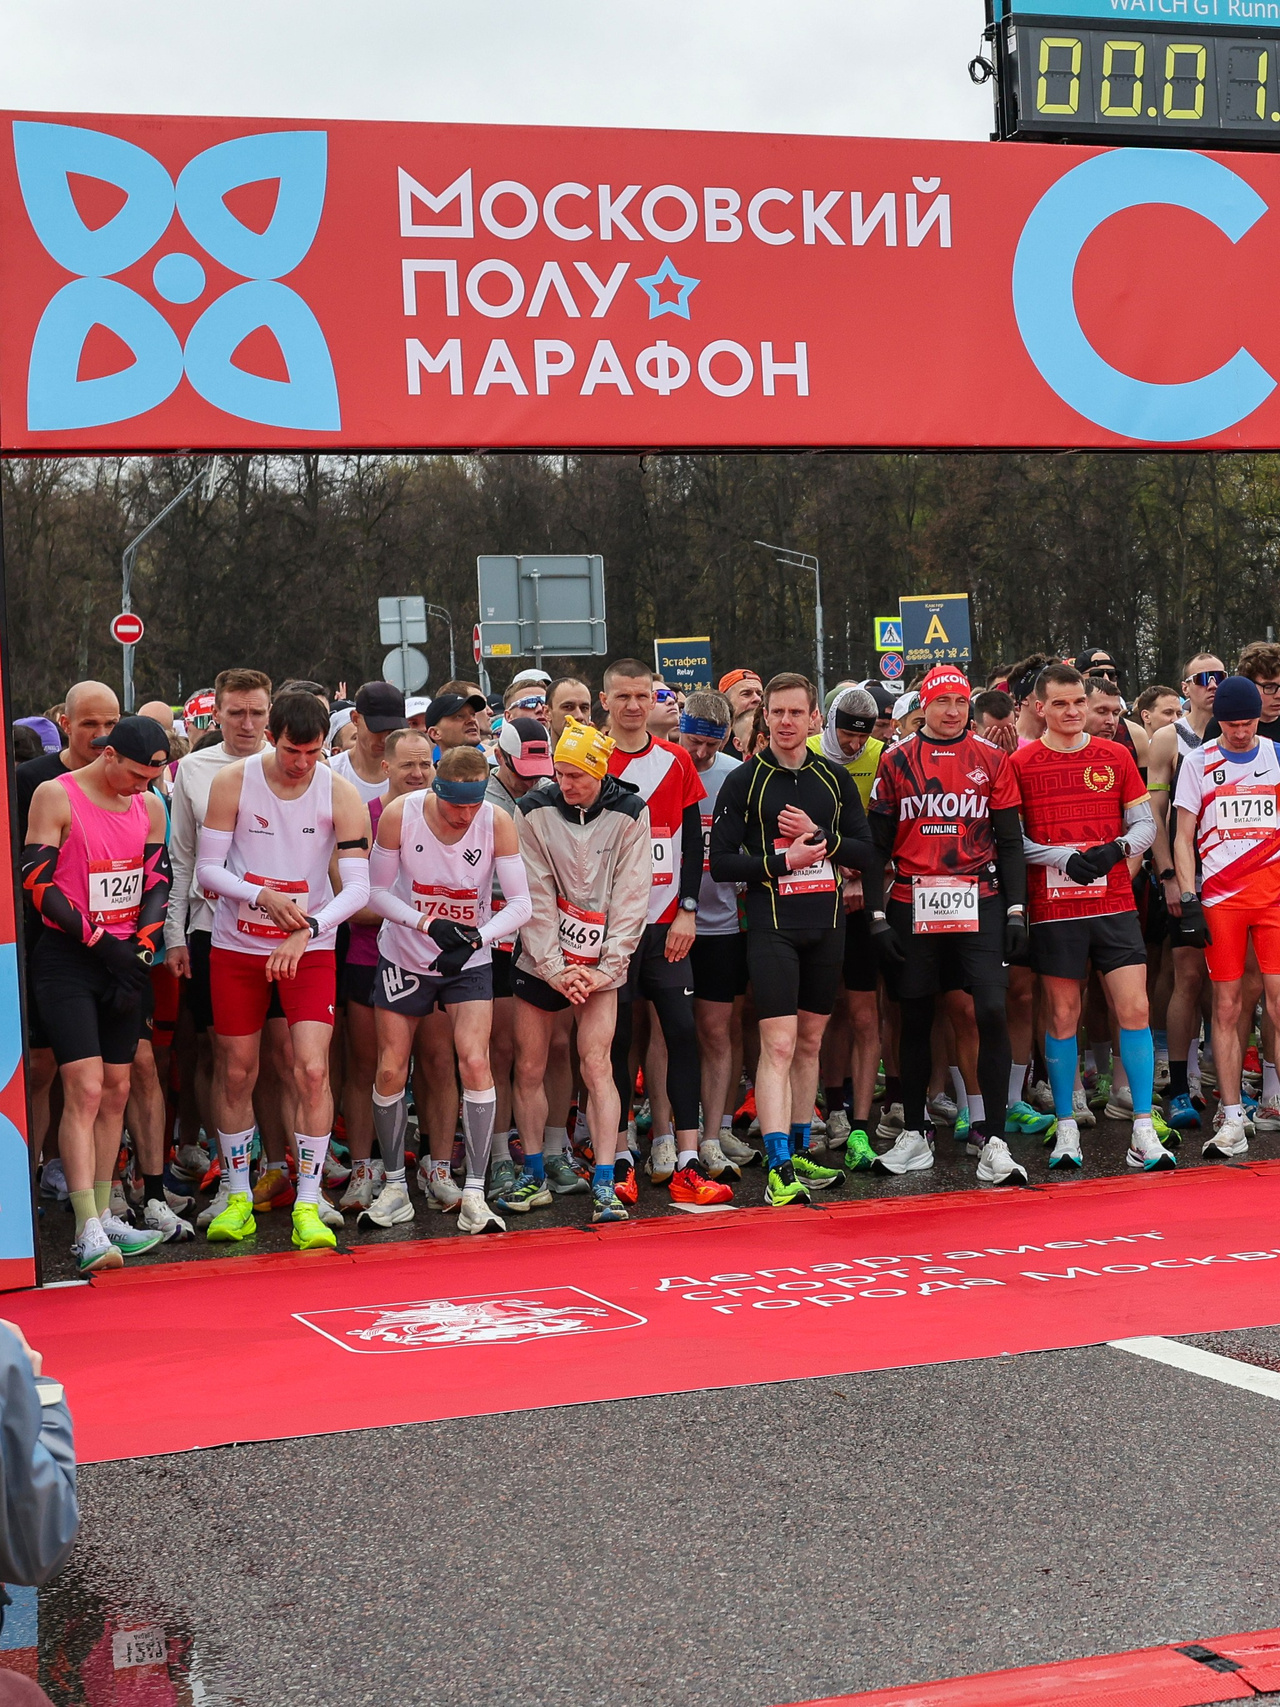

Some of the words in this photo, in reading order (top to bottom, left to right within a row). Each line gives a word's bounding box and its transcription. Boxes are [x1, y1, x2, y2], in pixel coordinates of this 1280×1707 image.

[401, 257, 631, 319] ПОЛУ
[405, 338, 811, 397] МАРАФОН
[924, 614, 949, 644] A
[662, 656, 708, 668] Эстафета
[676, 668, 695, 677] Relay
[927, 674, 969, 690] LUKOIL
[900, 788, 989, 821] ЛУКОЙЛ
[1219, 799, 1274, 818] 11718
[922, 825, 958, 834] WINLINE
[100, 873, 140, 898] 1247
[784, 883, 794, 894] A
[1052, 888, 1061, 898] A
[414, 899, 475, 920] 17655
[918, 891, 975, 910] 14090
[95, 911, 105, 922] A
[920, 921, 929, 932] A
[654, 1230, 1165, 1292] Департамент
[681, 1264, 966, 1301] спорта
[710, 1276, 1007, 1315] города
